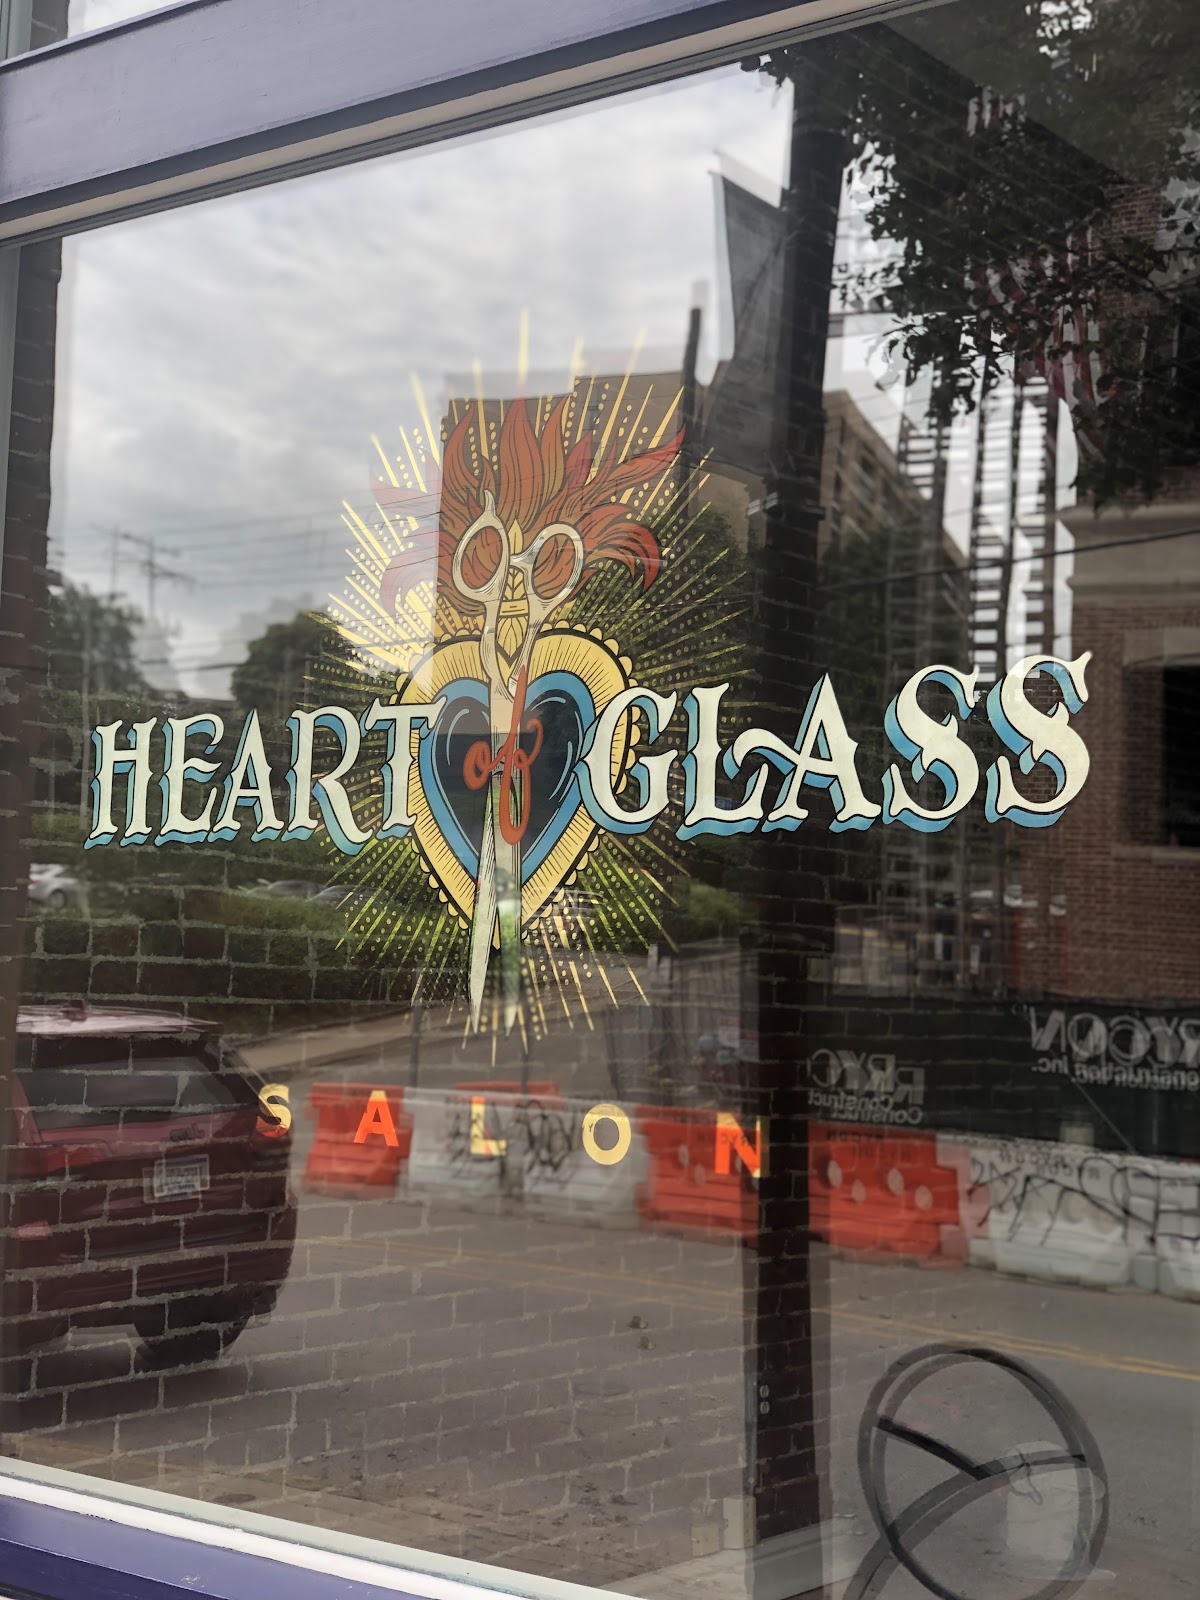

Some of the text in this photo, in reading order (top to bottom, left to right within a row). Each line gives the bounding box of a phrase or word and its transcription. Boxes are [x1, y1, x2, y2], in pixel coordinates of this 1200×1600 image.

[84, 650, 1093, 855] HEART of GLASS
[255, 1083, 767, 1178] SALON
